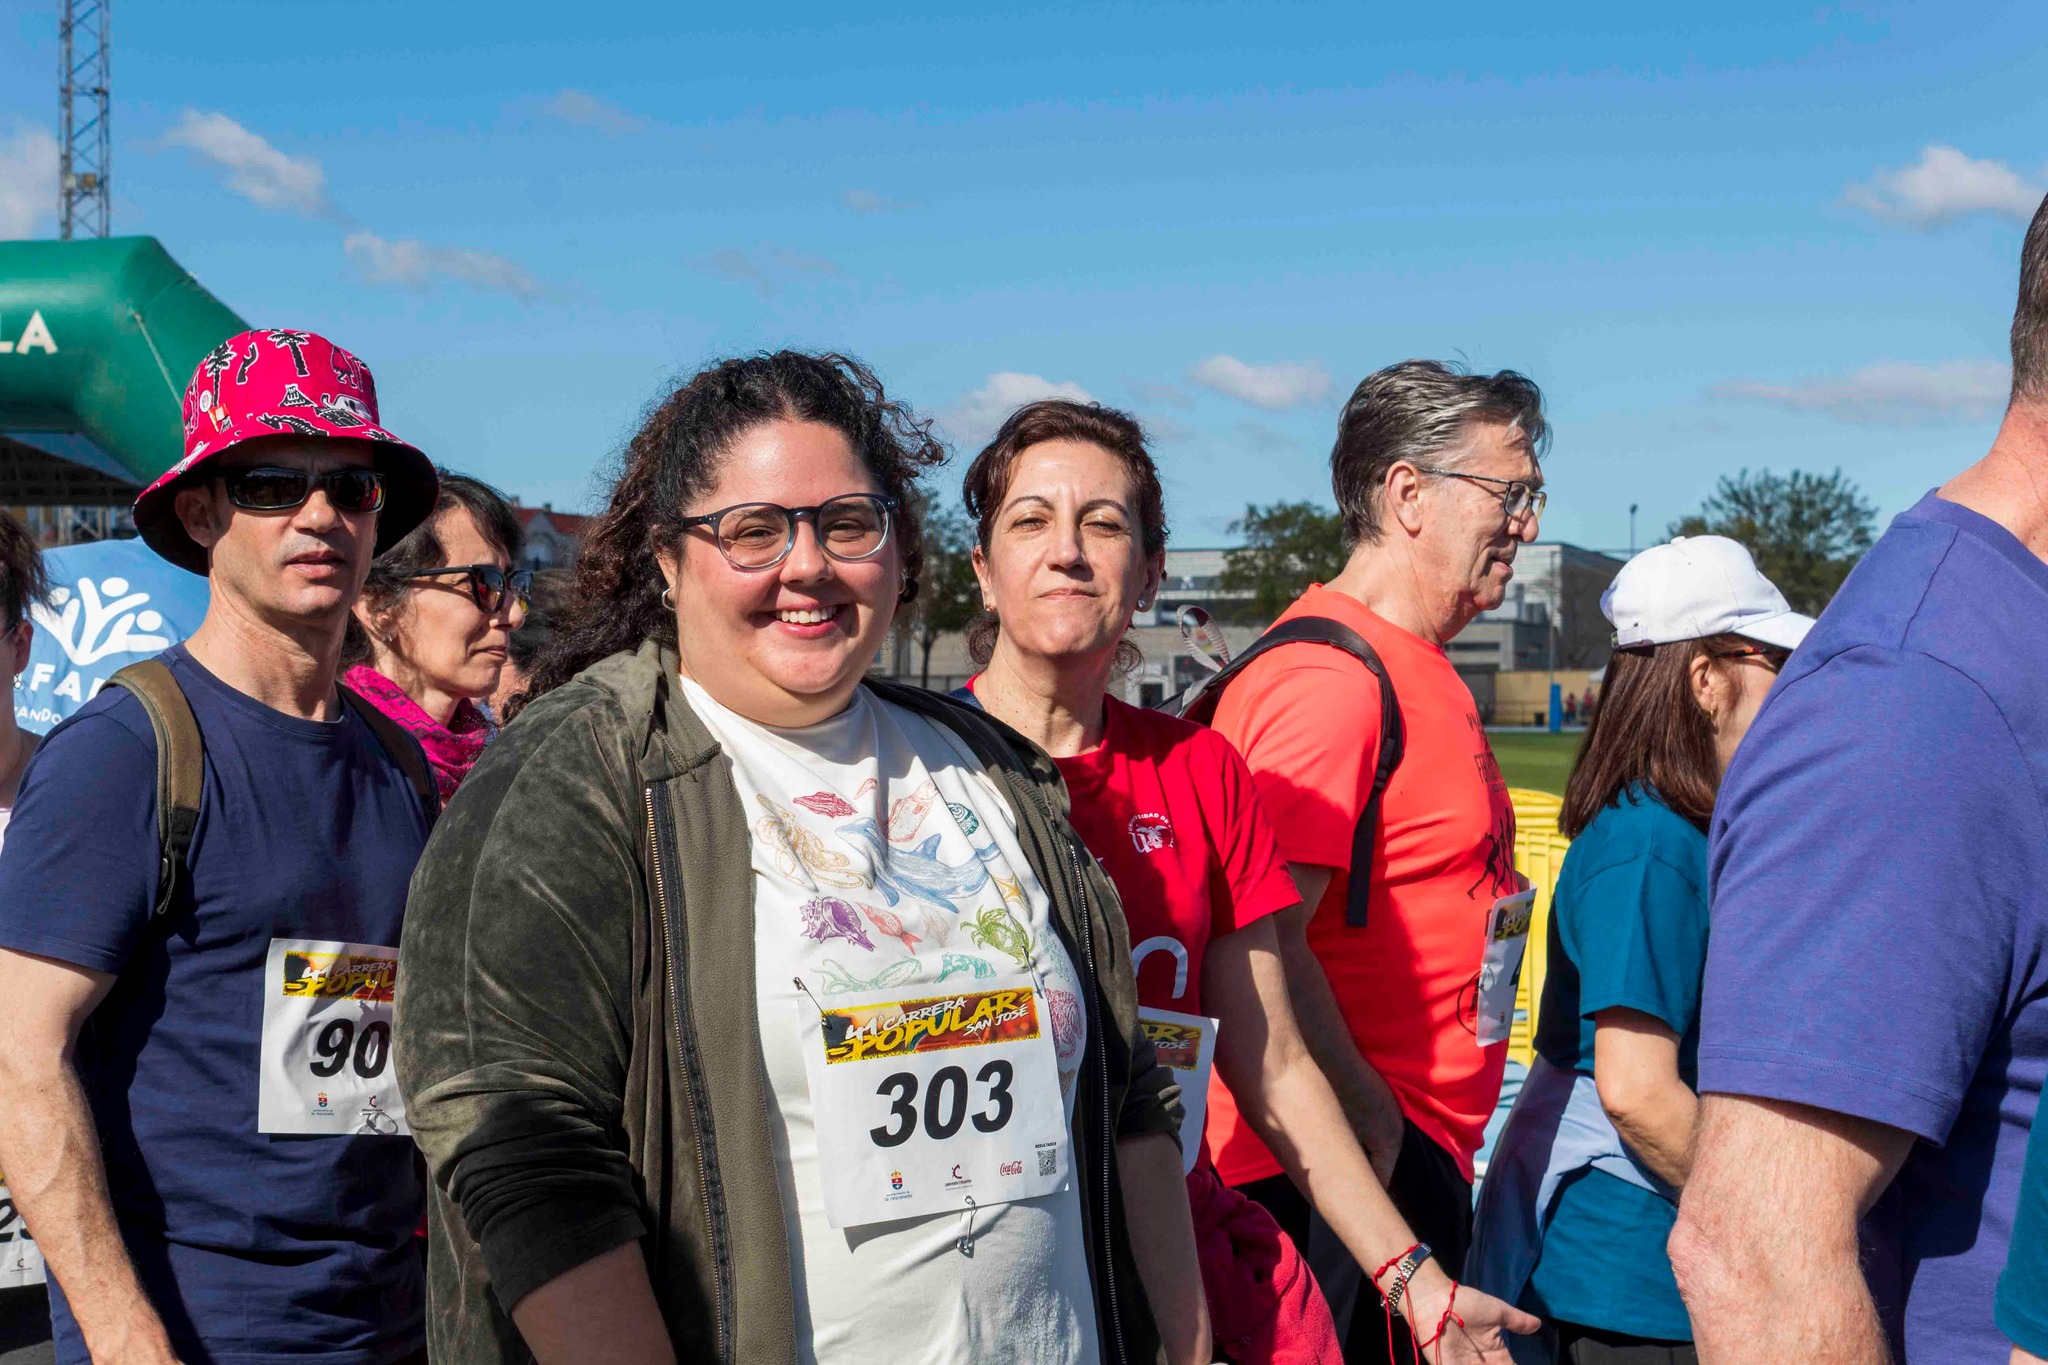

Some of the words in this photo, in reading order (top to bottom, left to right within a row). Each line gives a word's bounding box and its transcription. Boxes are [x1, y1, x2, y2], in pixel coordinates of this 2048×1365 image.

[15, 706, 62, 725] ANDO
[335, 961, 393, 977] CARRERA
[839, 991, 1019, 1058] POPULAR
[882, 996, 967, 1030] CARRERA
[962, 1018, 992, 1037] SAN
[996, 1004, 1029, 1025] JOSÉ
[309, 1018, 391, 1079] 90
[869, 1059, 1014, 1147] 303
